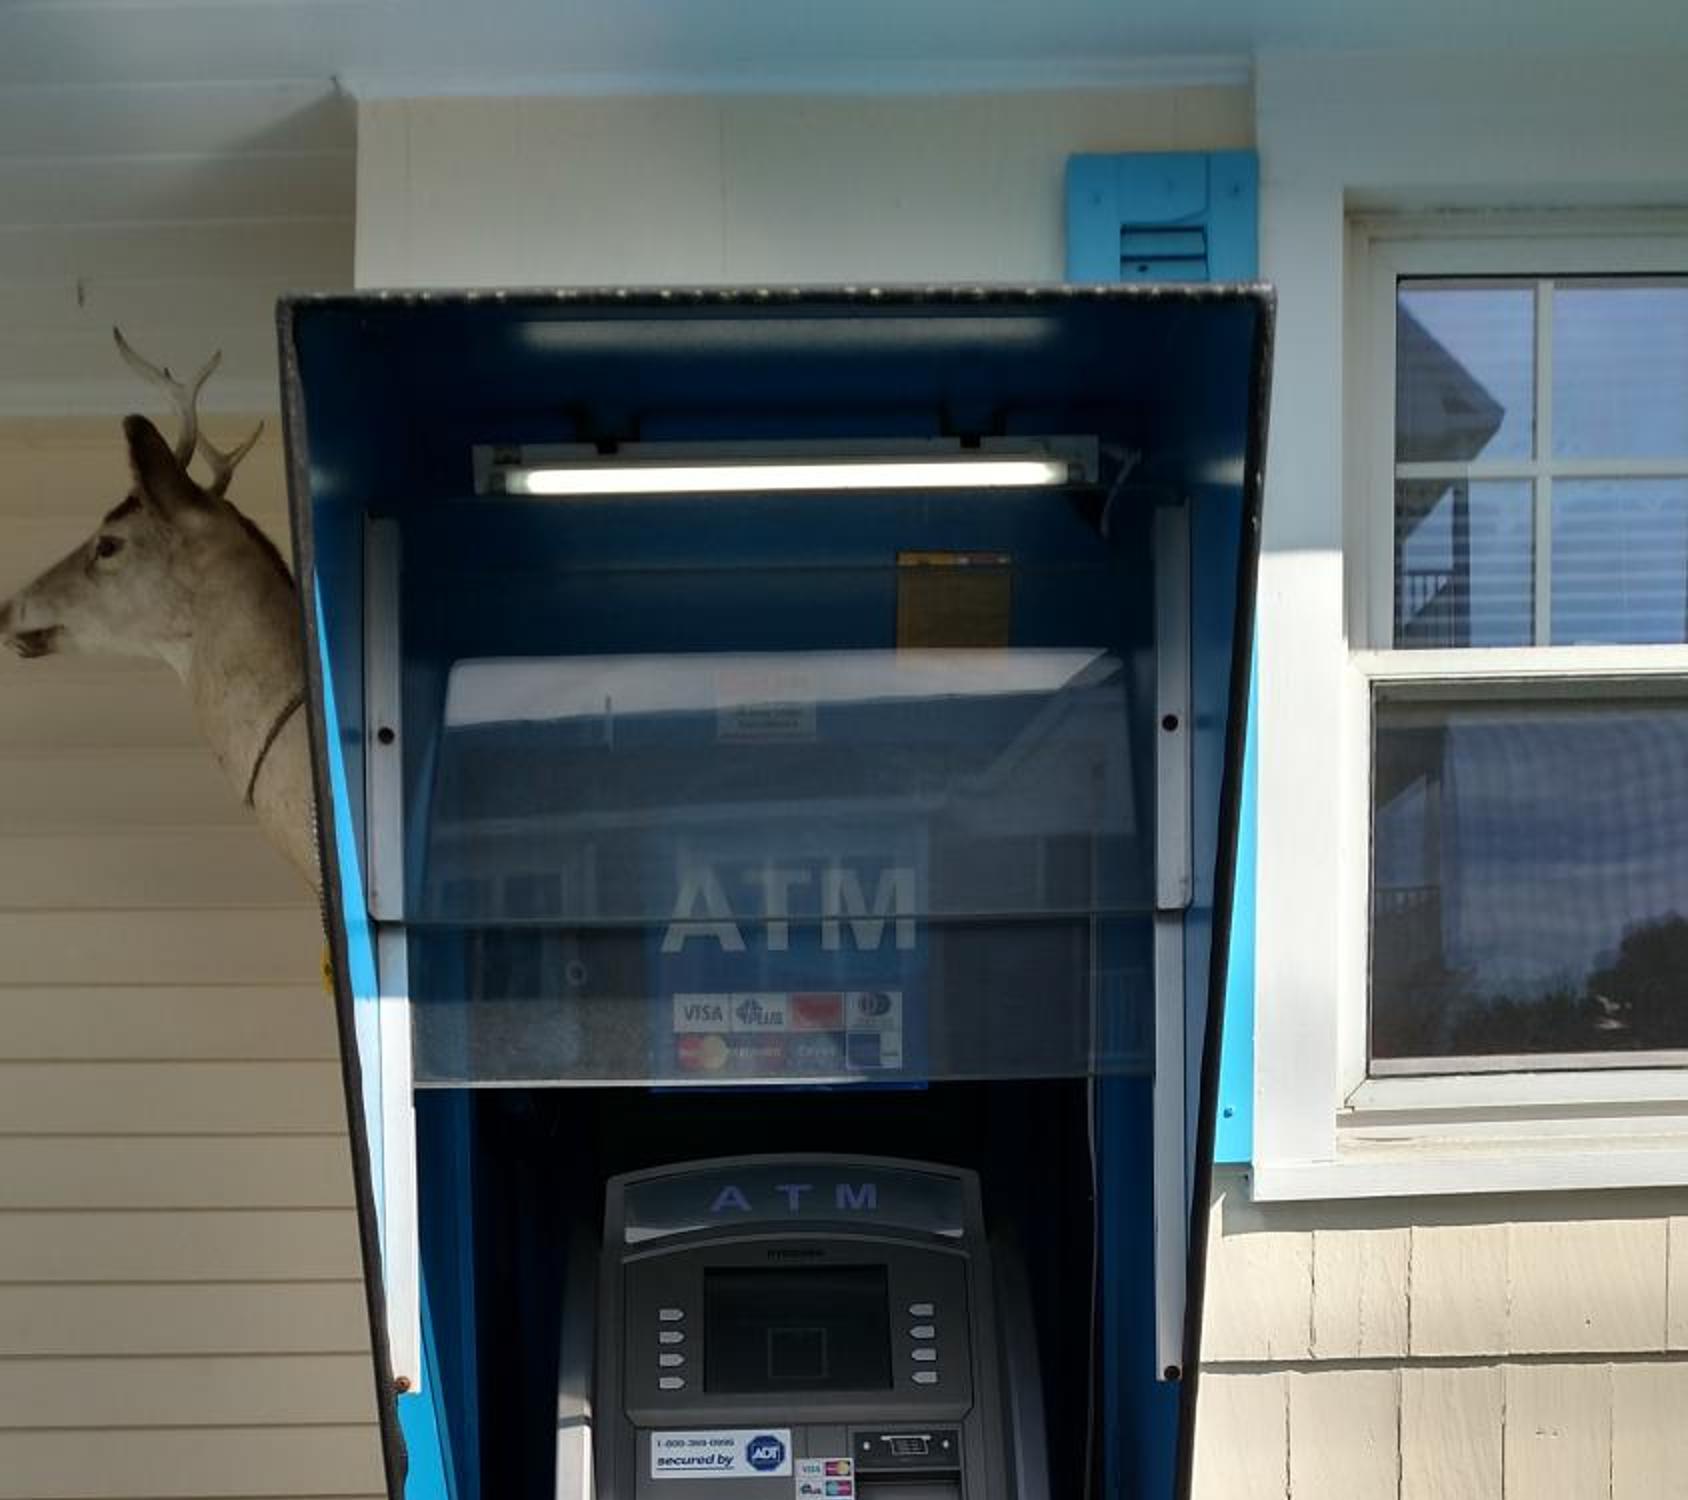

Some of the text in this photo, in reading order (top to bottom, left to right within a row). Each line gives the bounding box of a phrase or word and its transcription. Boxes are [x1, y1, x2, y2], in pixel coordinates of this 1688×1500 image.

[661, 867, 916, 953] ATM
[684, 1005, 723, 1023] VISA
[709, 1183, 878, 1212] ATM
[657, 1453, 735, 1469] secured by
[751, 1446, 780, 1460] ADT
